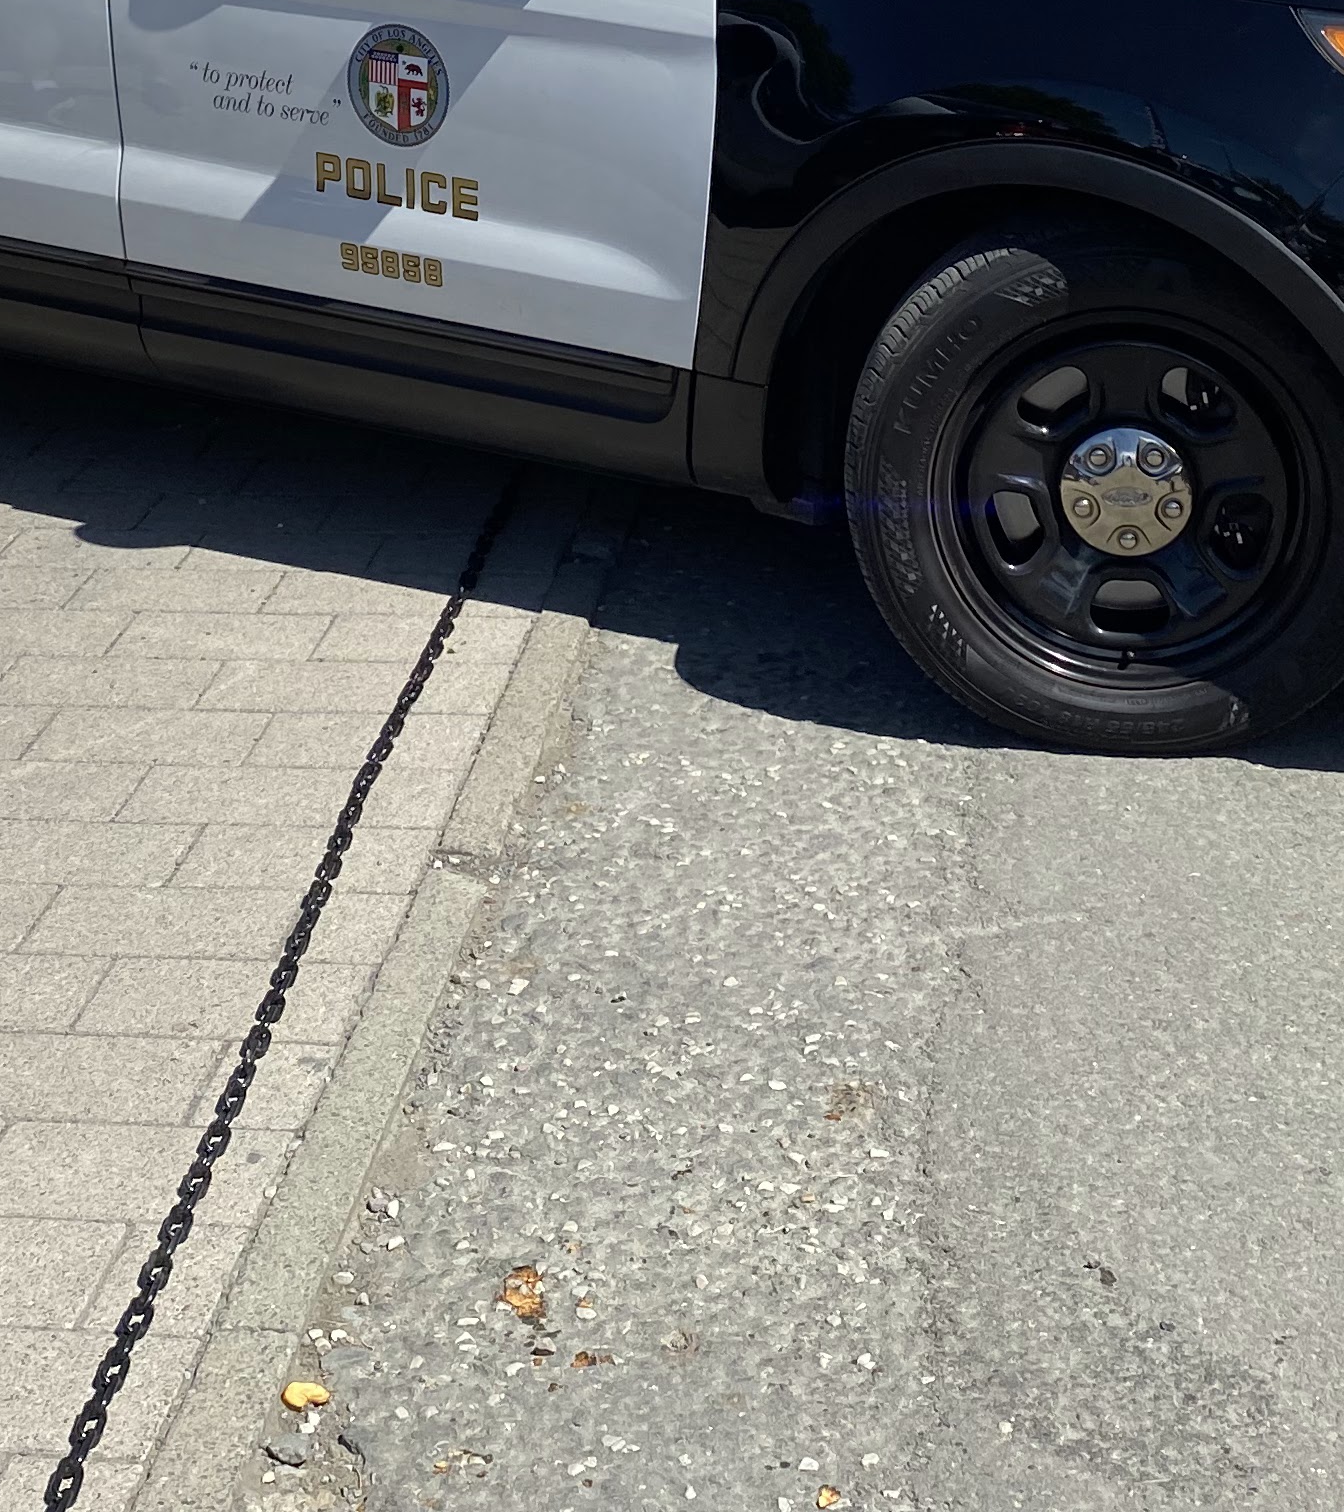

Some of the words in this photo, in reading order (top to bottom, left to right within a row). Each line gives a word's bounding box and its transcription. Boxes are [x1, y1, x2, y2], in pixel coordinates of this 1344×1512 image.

[355, 39, 372, 63] CITY
[371, 31, 384, 43] OF
[387, 28, 406, 39] LOS
[408, 34, 444, 76] ANGELES
[224, 70, 294, 95] protect
[213, 92, 251, 114] and
[256, 95, 274, 117] to
[362, 112, 410, 143] FOUNDED
[413, 123, 434, 141] 1781
[315, 151, 479, 221] POLICE
